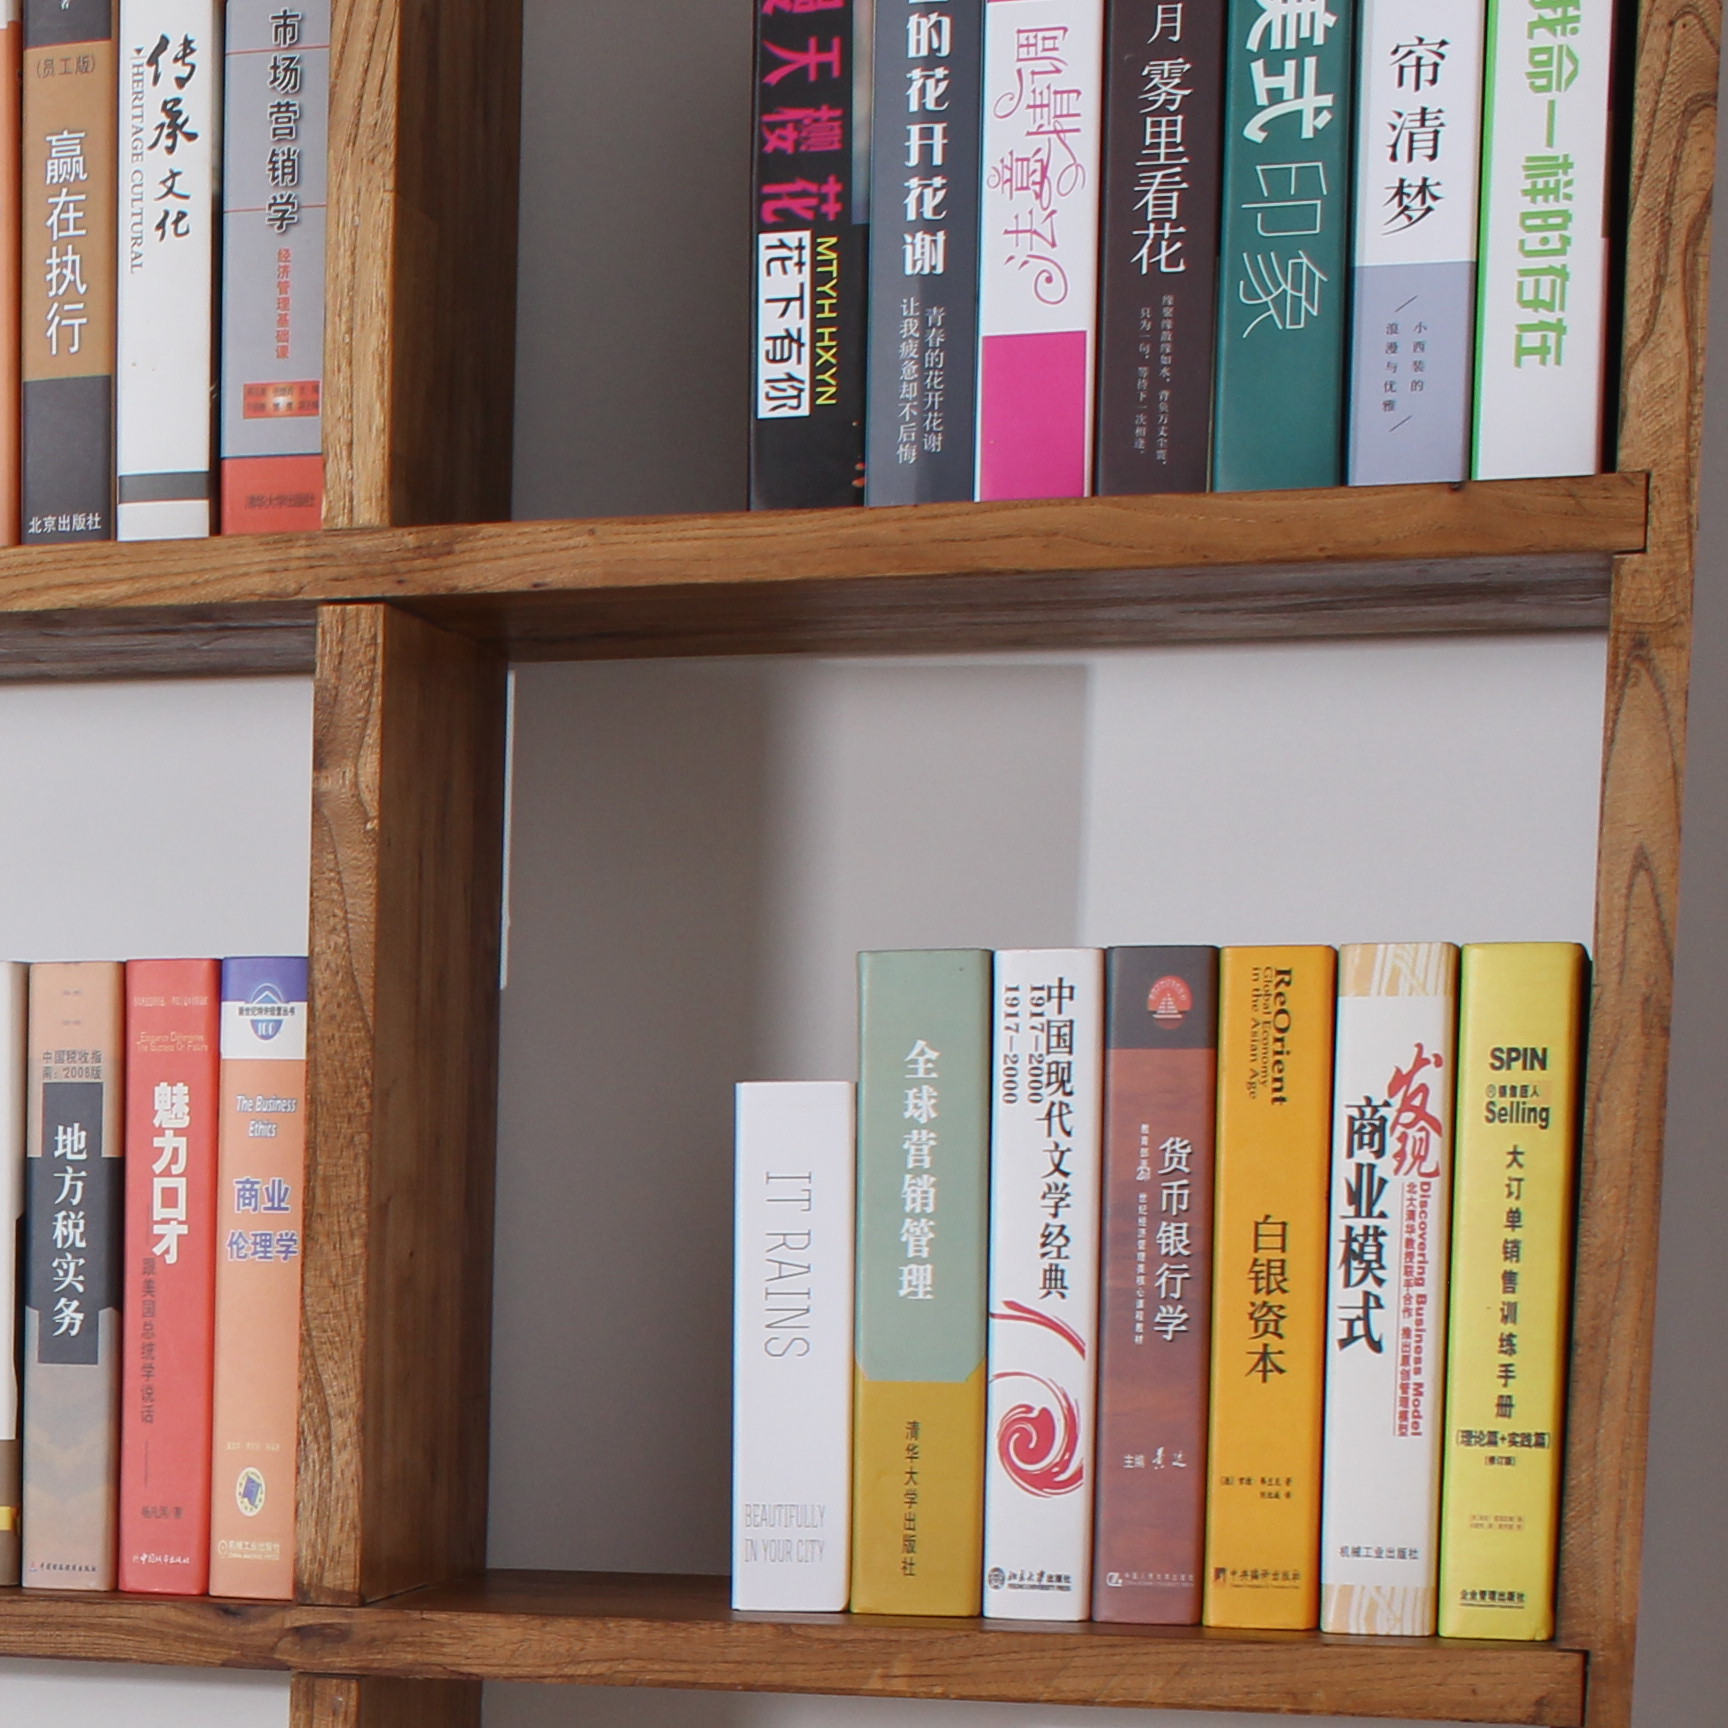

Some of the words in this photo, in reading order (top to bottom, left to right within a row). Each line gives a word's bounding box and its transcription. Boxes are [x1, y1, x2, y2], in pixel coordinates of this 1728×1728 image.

[129, 62, 144, 163] HERITAGE
[146, 33, 200, 243] 传承文化
[266, 9, 303, 234] 市场营销学
[1381, 35, 1449, 236] 帘清梦
[43, 129, 90, 356] 赢在执行
[128, 170, 144, 274] CULTURAL
[764, 238, 807, 414] 花下有你
[815, 236, 838, 319] MTYH
[814, 326, 838, 406] HXYN
[896, 297, 920, 465] 让我疲惫却不后悔
[922, 306, 945, 454] 青春的花开花谢
[1382, 321, 1400, 413] 浪漫与优雅
[1410, 320, 1428, 393] 小西装的
[28, 513, 102, 534] 北京出版社
[1270, 966, 1293, 1107] ReOrient
[1488, 1047, 1548, 1072] SPIN
[236, 1095, 253, 1112] The
[256, 1096, 297, 1113] Business
[248, 1120, 277, 1138] Ethics
[1036, 976, 1076, 1301] 中国现代文学经典
[1387, 1042, 1444, 1180] 发现
[1484, 1100, 1550, 1129] Selling
[152, 1081, 191, 1265] 魅力口才
[233, 1176, 291, 1216] 商业
[764, 1170, 813, 1212] IT
[897, 1038, 942, 1302] 全球营销管理
[52, 1124, 88, 1338] 地方税实务
[226, 1231, 299, 1263] 伦理学
[1153, 1136, 1193, 1343] 货币银行学
[1336, 1095, 1392, 1354] 商业模式
[1414, 1181, 1431, 1286] Discovering
[764, 1230, 812, 1360] RAINS
[1245, 1214, 1291, 1384] 白银资本
[1494, 1144, 1526, 1419] 大订单销售训练手册
[140, 1258, 156, 1426] 跟美国总统学说话
[1413, 1294, 1427, 1376] Business
[1411, 1382, 1424, 1437] Model
[744, 1503, 827, 1529] BEAUTIFULLY
[744, 1537, 758, 1564] IN
[762, 1538, 794, 1564] YOUR
[797, 1538, 826, 1564] CITY
[901, 1419, 921, 1578] 清华大学出版社
[1340, 1546, 1419, 1560] 机械工业出版社
[1460, 1589, 1525, 1603] 企业管理出版社
